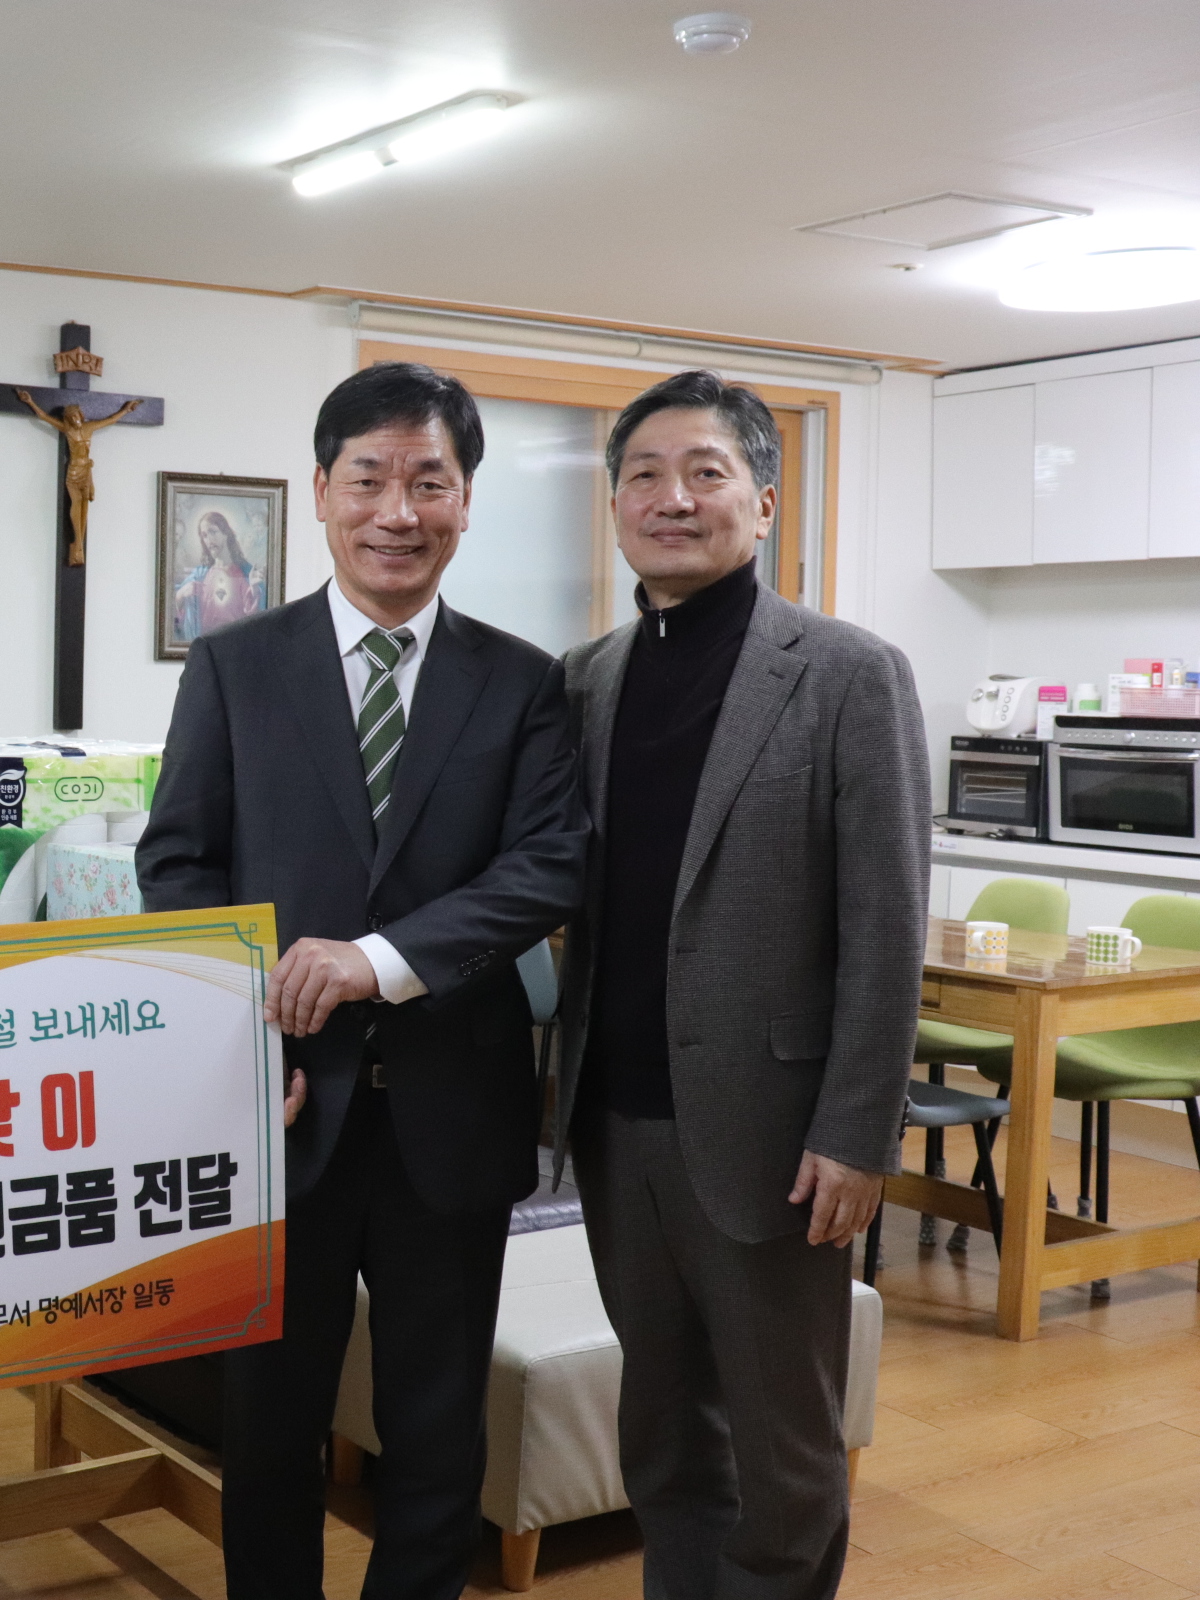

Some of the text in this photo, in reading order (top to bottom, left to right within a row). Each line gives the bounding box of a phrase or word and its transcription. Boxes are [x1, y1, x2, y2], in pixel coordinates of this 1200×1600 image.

[60, 353, 100, 371] INRI
[0, 784, 19, 794] 친환경
[29, 999, 166, 1043] 보내세요
[133, 1152, 238, 1239] 전달
[38, 1287, 128, 1324] 명예서장
[133, 1278, 175, 1309] 일동
